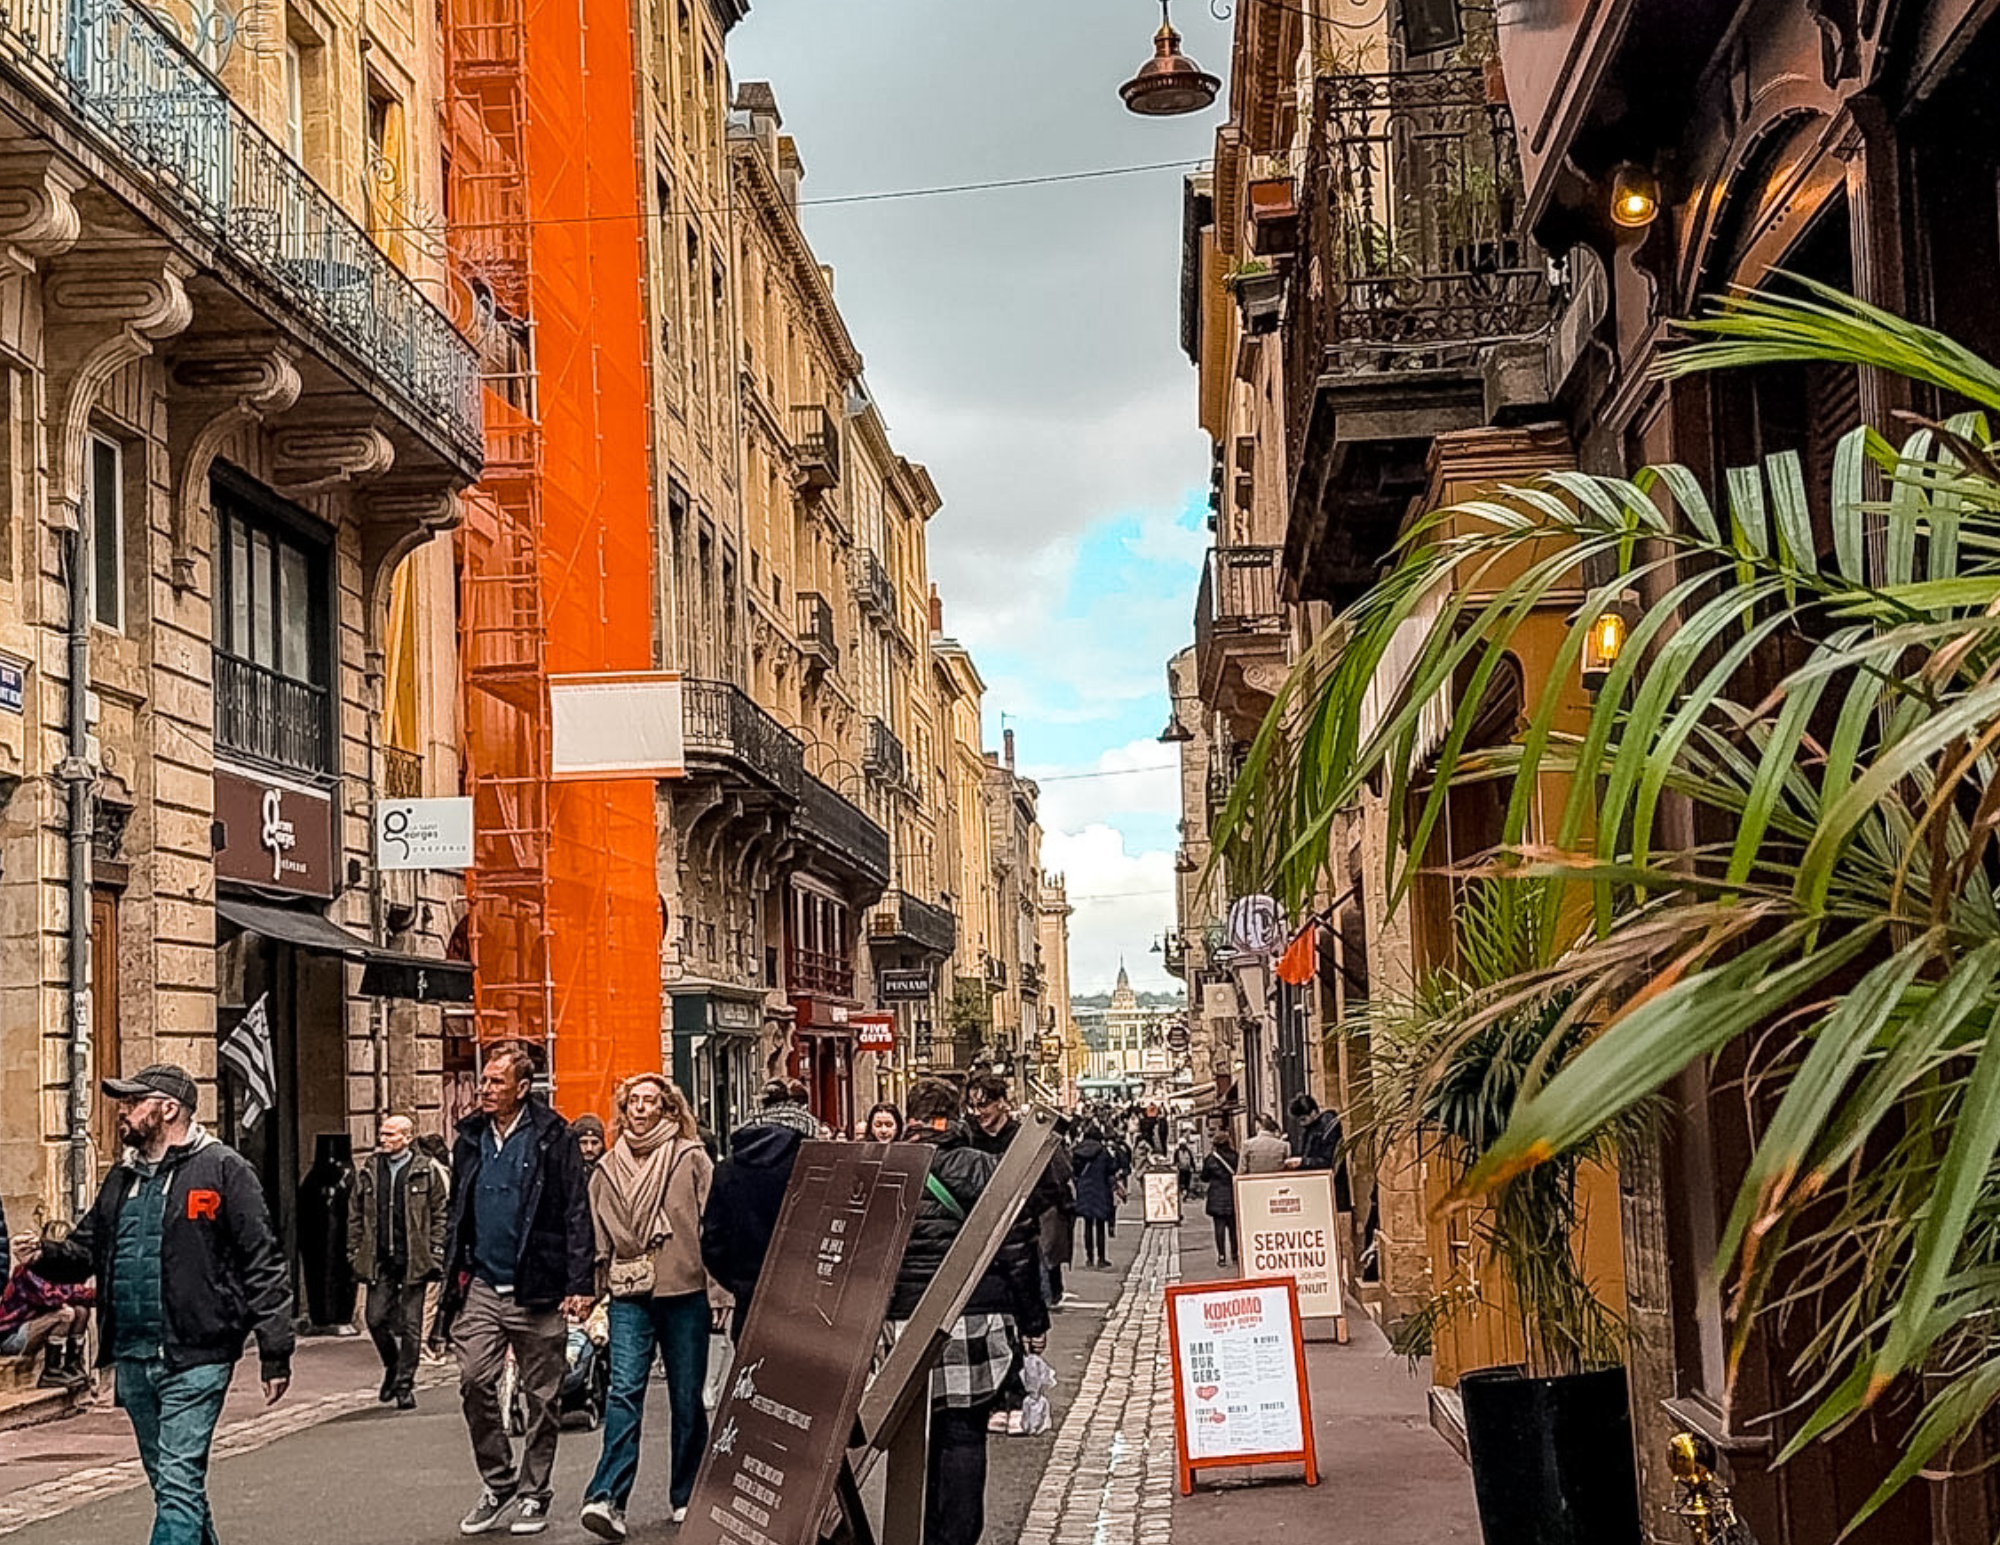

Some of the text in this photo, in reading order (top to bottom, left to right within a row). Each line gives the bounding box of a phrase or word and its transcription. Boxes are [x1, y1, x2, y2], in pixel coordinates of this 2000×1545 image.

[860, 1033, 892, 1042] GUYS
[863, 1023, 889, 1034] FIVE
[187, 1189, 220, 1220] R
[1254, 1230, 1325, 1251] SERVICE
[1255, 1251, 1326, 1270] CONTINU
[1203, 1296, 1262, 1321] KOKOMO
[1192, 1369, 1221, 1383] GERS
